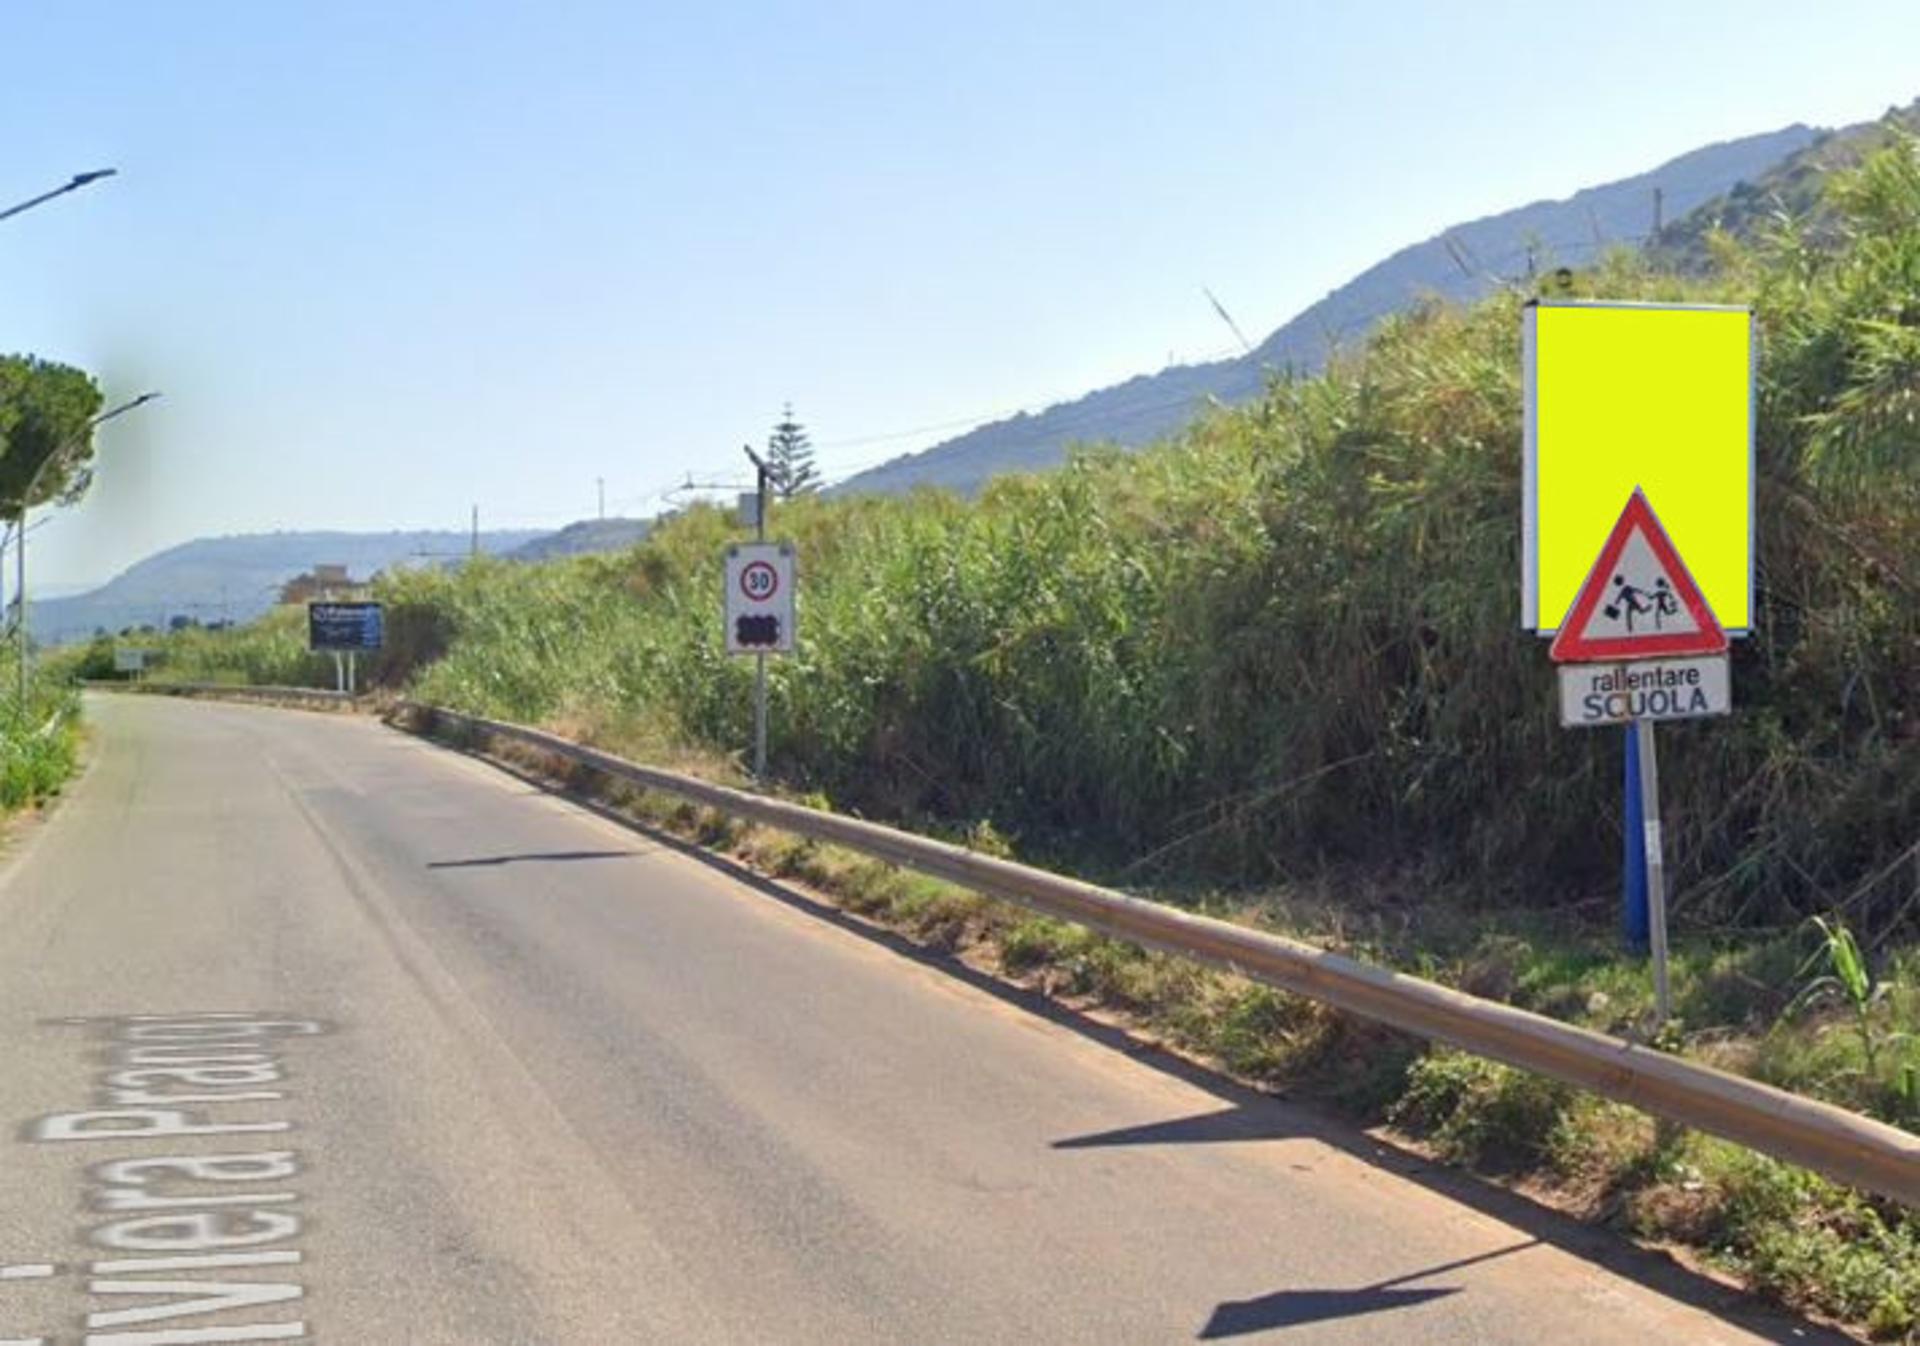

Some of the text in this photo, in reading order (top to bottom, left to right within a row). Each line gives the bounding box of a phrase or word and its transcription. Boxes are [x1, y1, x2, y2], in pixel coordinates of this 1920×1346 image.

[750, 571, 769, 590] 30
[1592, 667, 1700, 691] rallentare
[1583, 687, 1708, 719] SCUOLA
